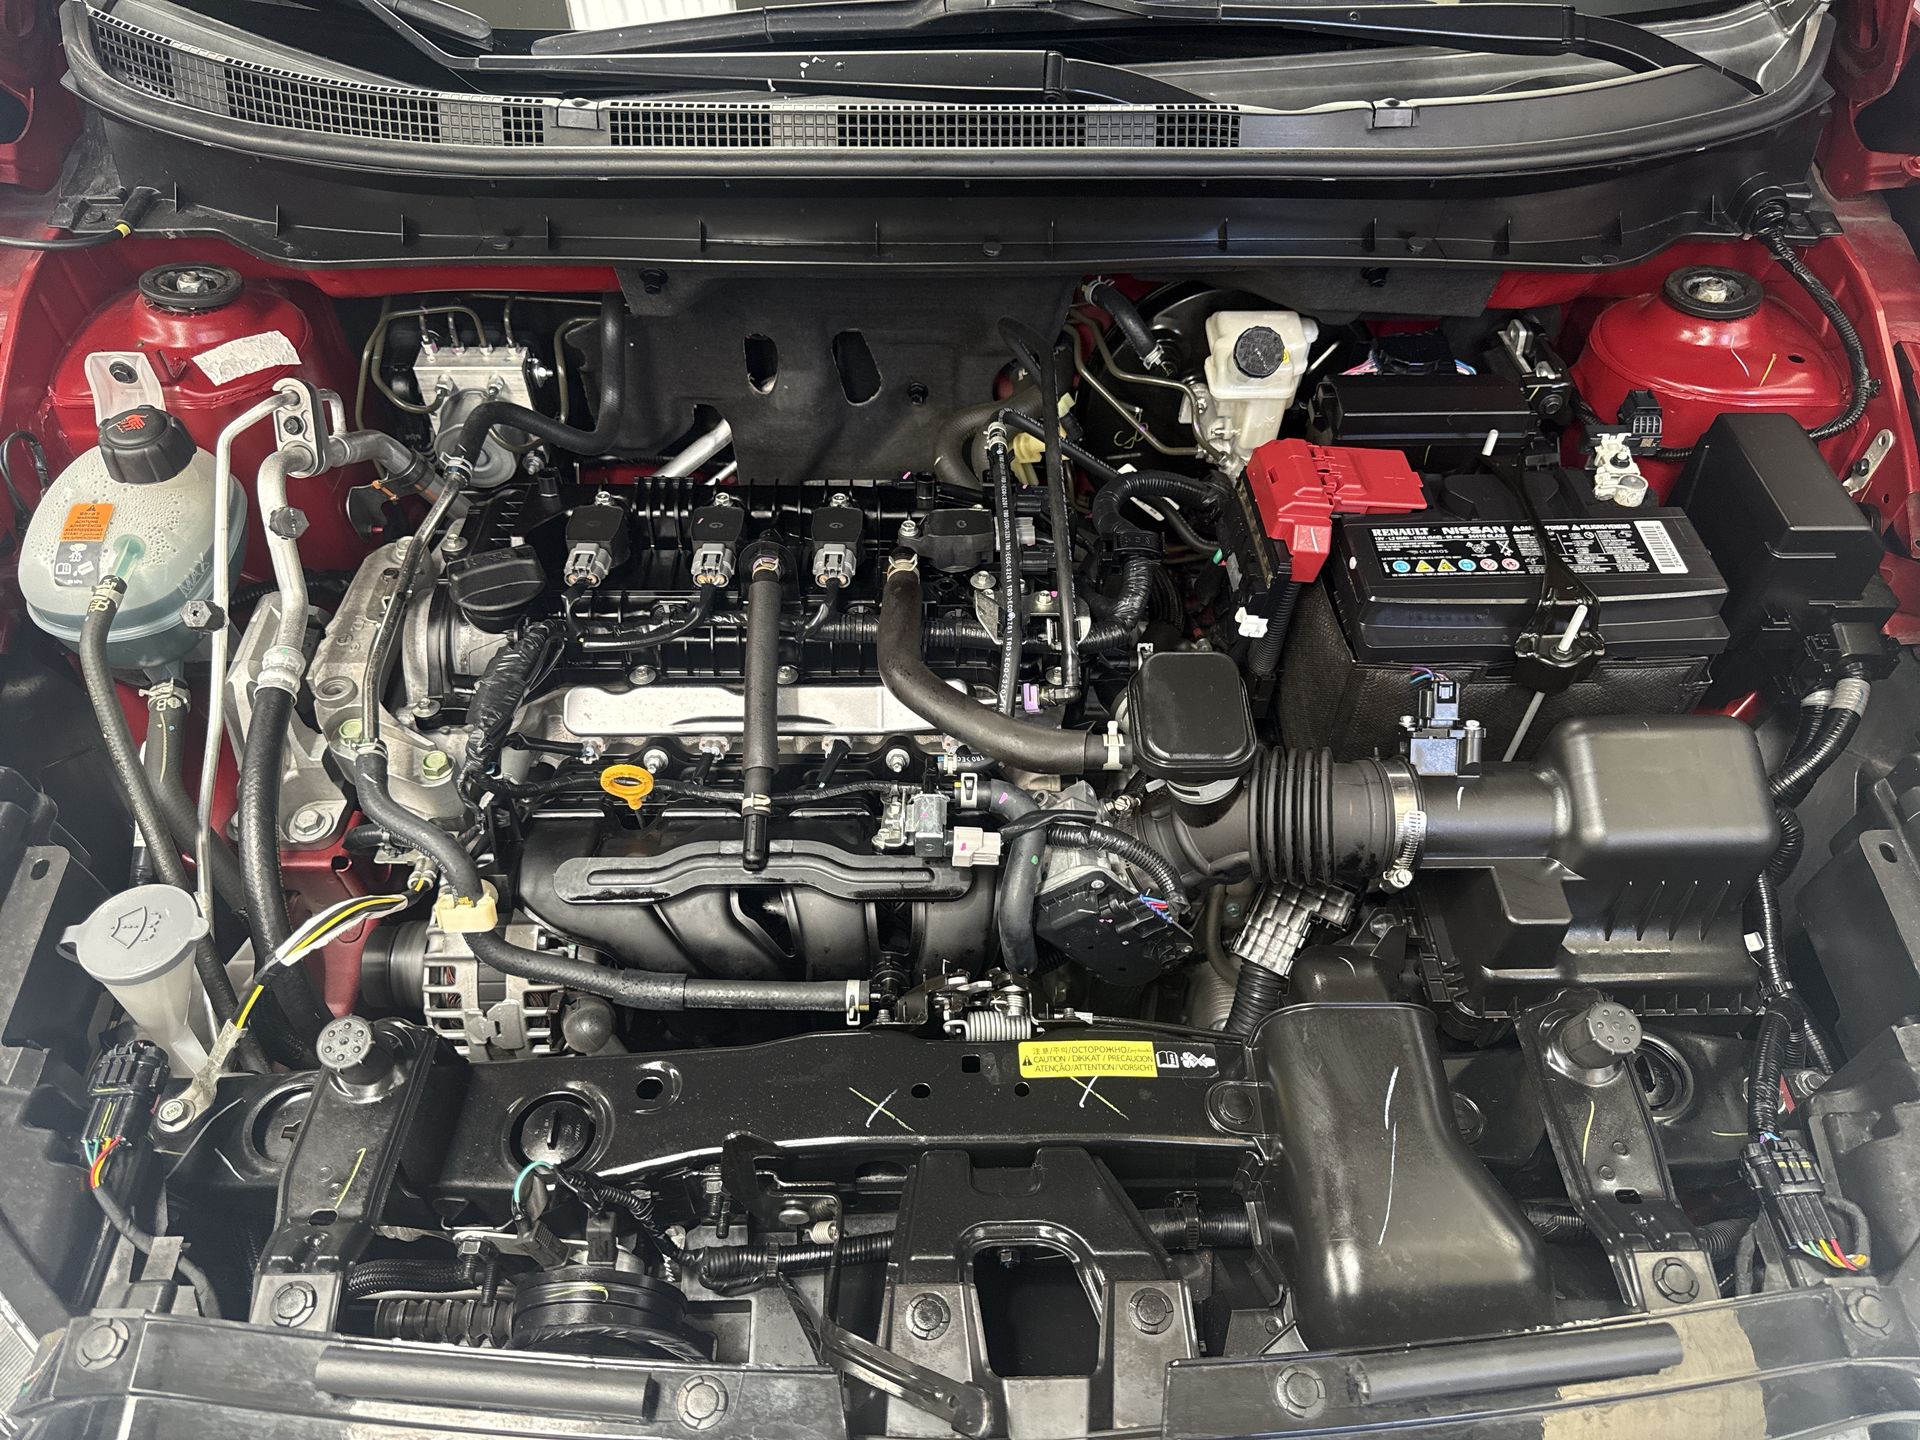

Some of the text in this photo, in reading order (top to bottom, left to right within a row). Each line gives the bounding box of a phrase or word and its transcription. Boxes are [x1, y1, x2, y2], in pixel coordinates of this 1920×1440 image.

[1371, 525, 1507, 536] RENAULT NISSAN
[1033, 1055, 1066, 1063] CAUTION
